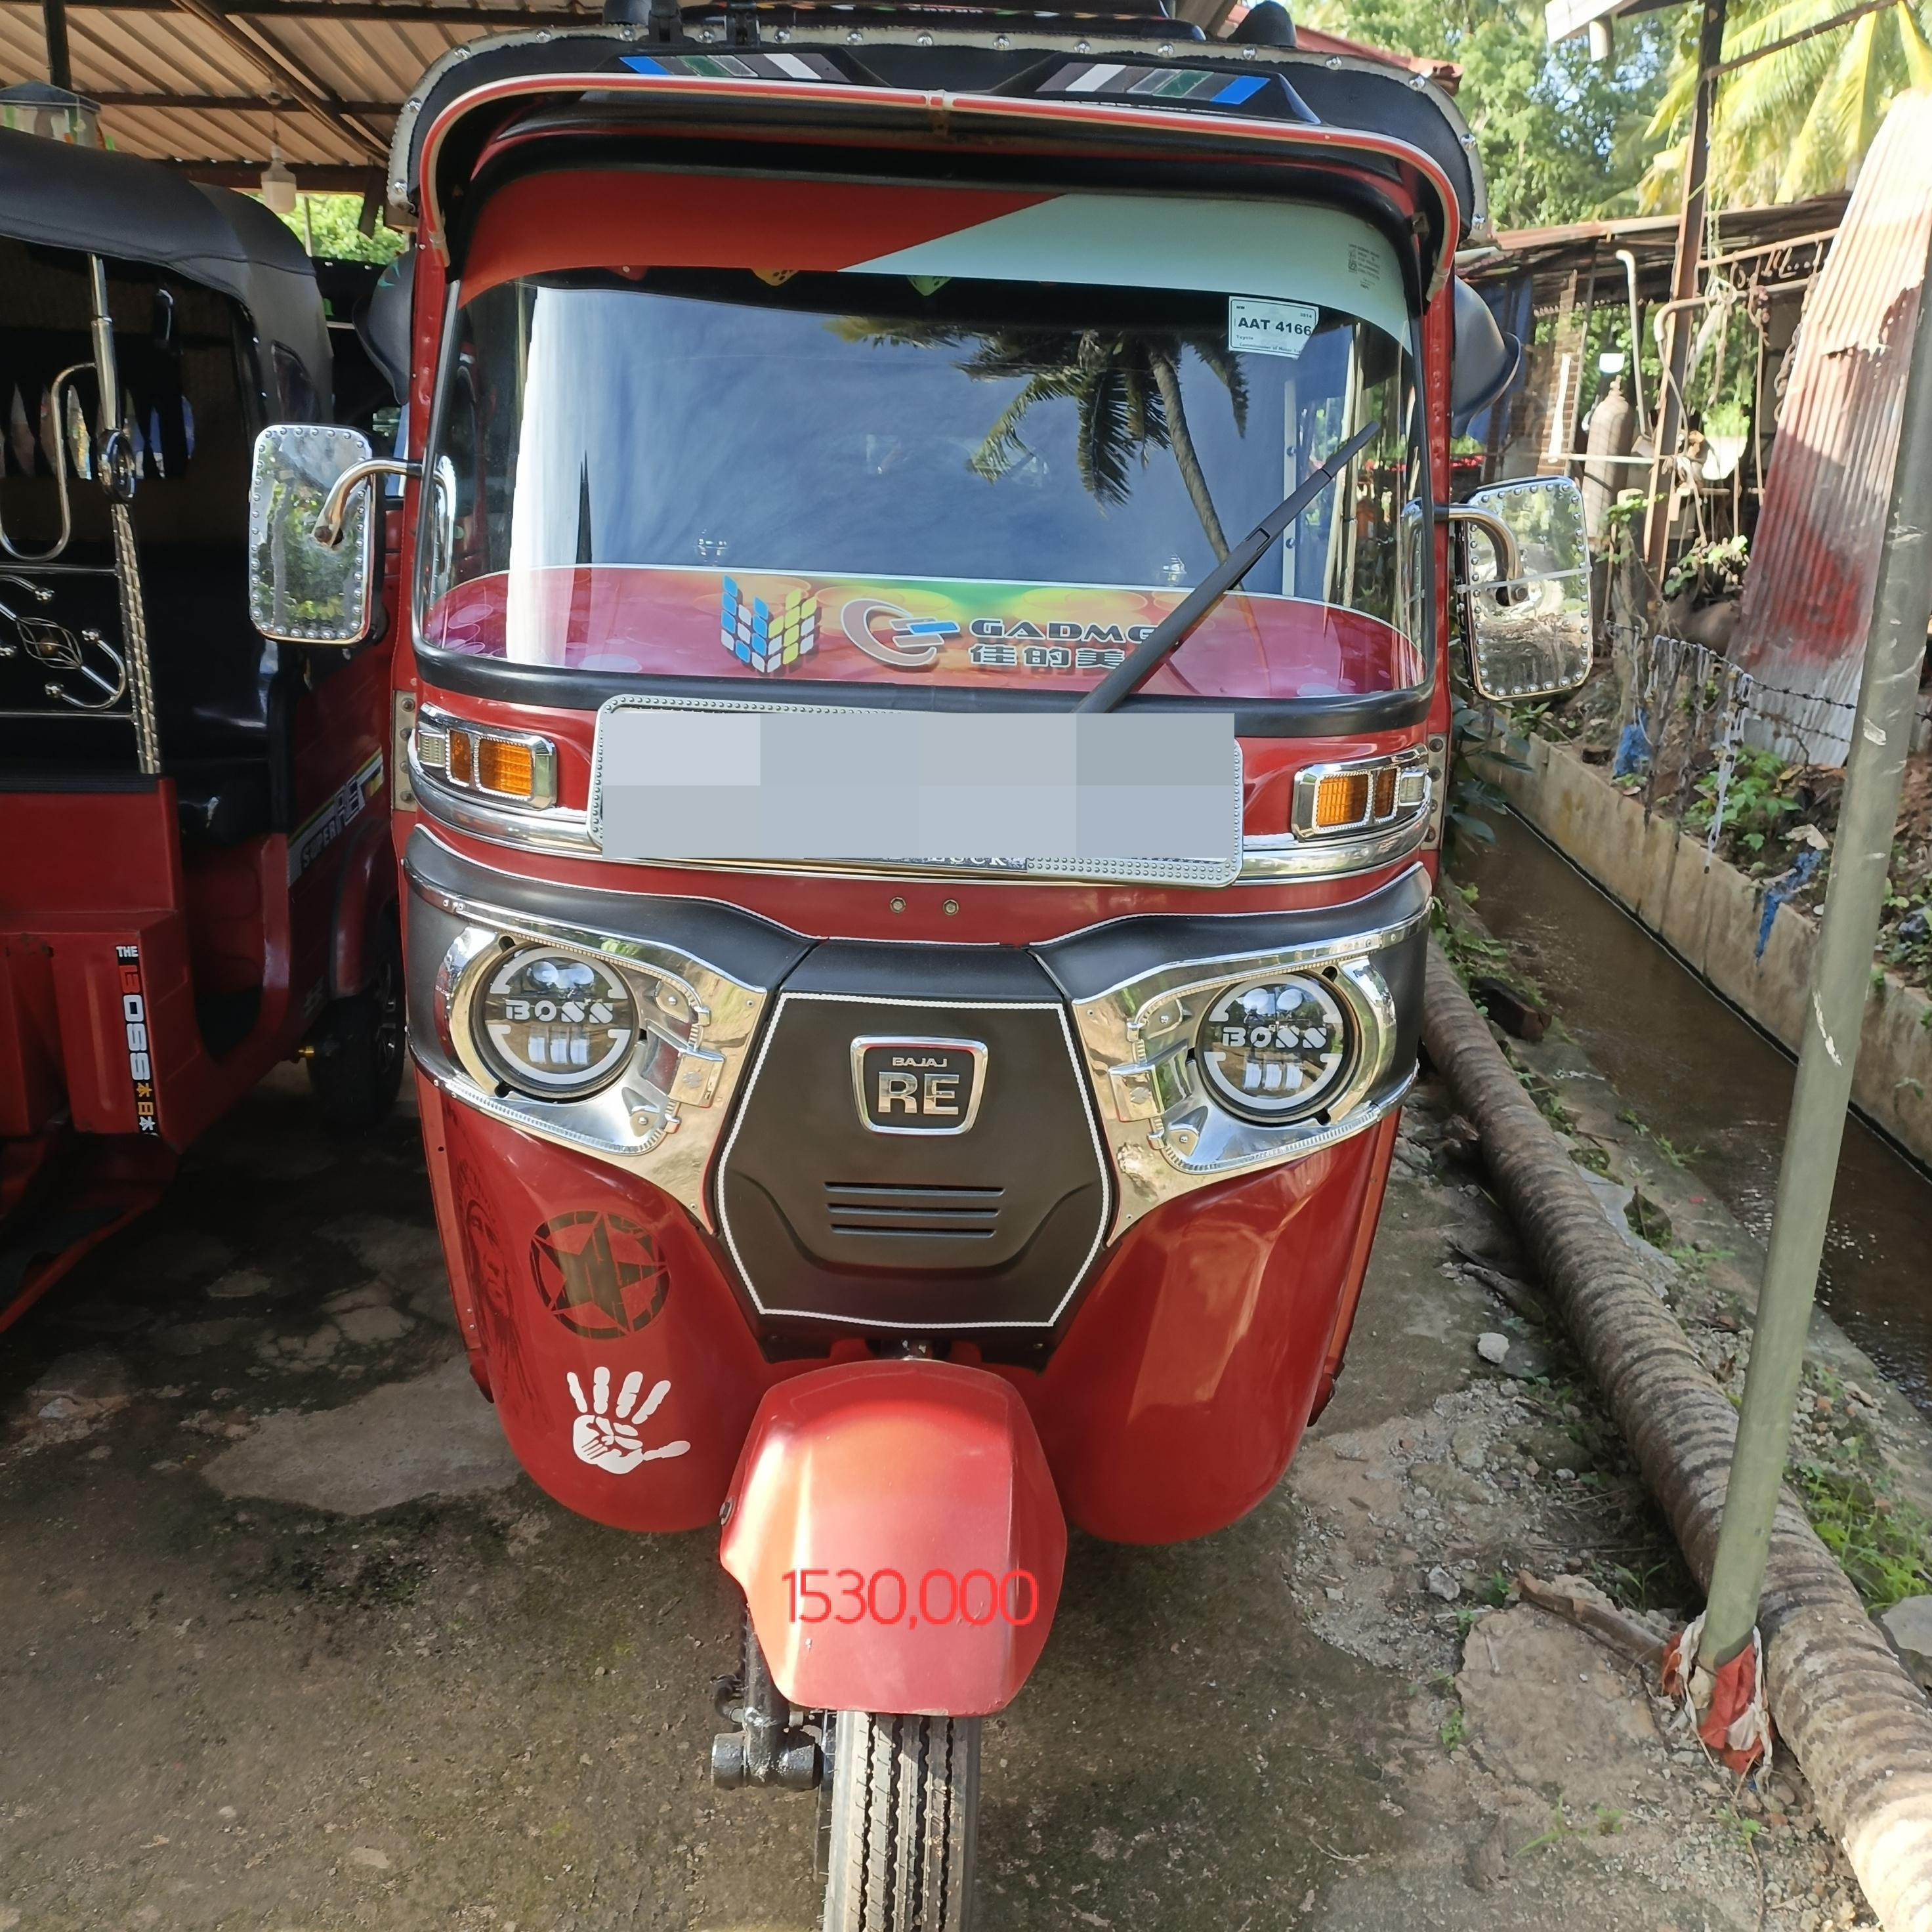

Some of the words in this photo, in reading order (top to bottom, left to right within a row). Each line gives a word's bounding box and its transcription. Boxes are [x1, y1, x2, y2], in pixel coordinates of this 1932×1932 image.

[1238, 317, 1270, 329] AAT
[1275, 321, 1311, 336] 4166
[969, 644, 1125, 668] 佳的美
[303, 818, 337, 868] SUPER
[116, 946, 139, 957] THE
[118, 965, 151, 1081] BOSS
[504, 999, 613, 1024] BOSS
[1222, 1026, 1327, 1049] BOSS
[892, 1057, 948, 1068] BAJAJ
[878, 1072, 959, 1115] RE
